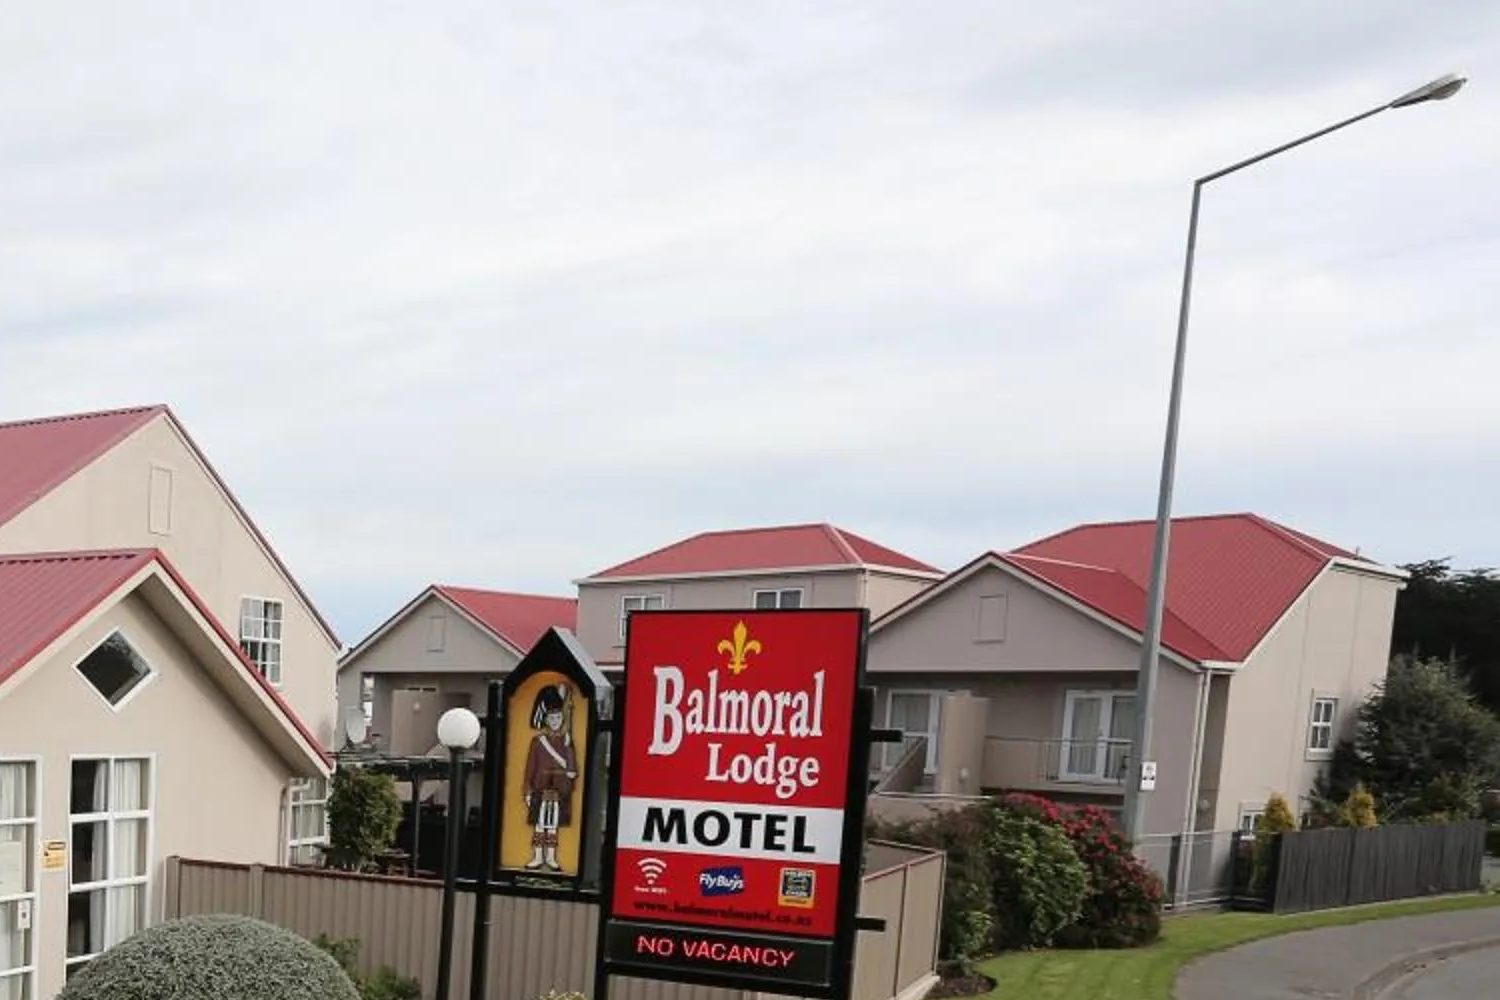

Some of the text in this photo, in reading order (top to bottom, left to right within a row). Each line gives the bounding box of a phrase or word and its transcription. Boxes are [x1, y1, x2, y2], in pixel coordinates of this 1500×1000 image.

[648, 665, 825, 756] Balmoral
[705, 742, 820, 799] Lodge
[642, 807, 816, 853] MOTEL
[637, 935, 795, 967] NO VACANCY
